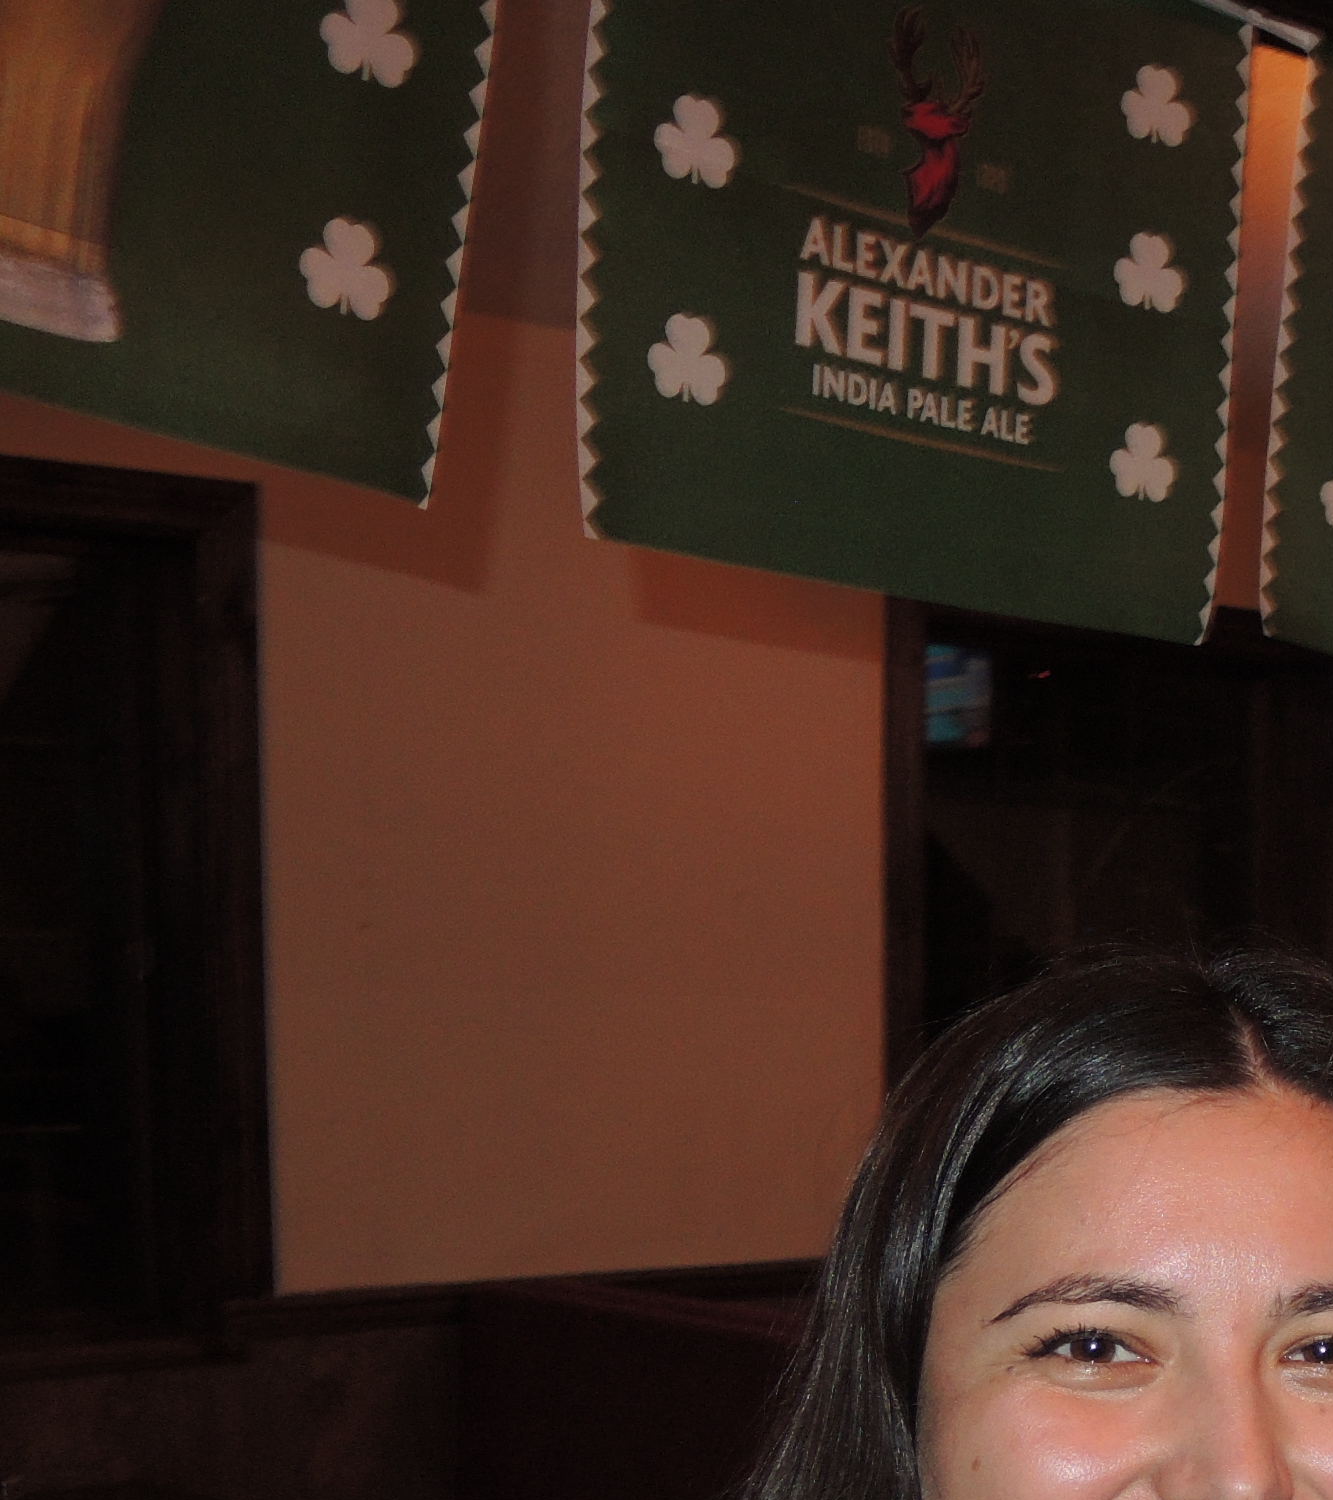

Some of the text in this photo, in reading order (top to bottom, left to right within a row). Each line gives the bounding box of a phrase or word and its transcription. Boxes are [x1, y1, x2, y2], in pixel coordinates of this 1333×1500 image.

[800, 216, 1056, 326] ALEXANDER
[795, 271, 1061, 406] KEITH'S
[812, 363, 1034, 445] INDIA PALE ALE
